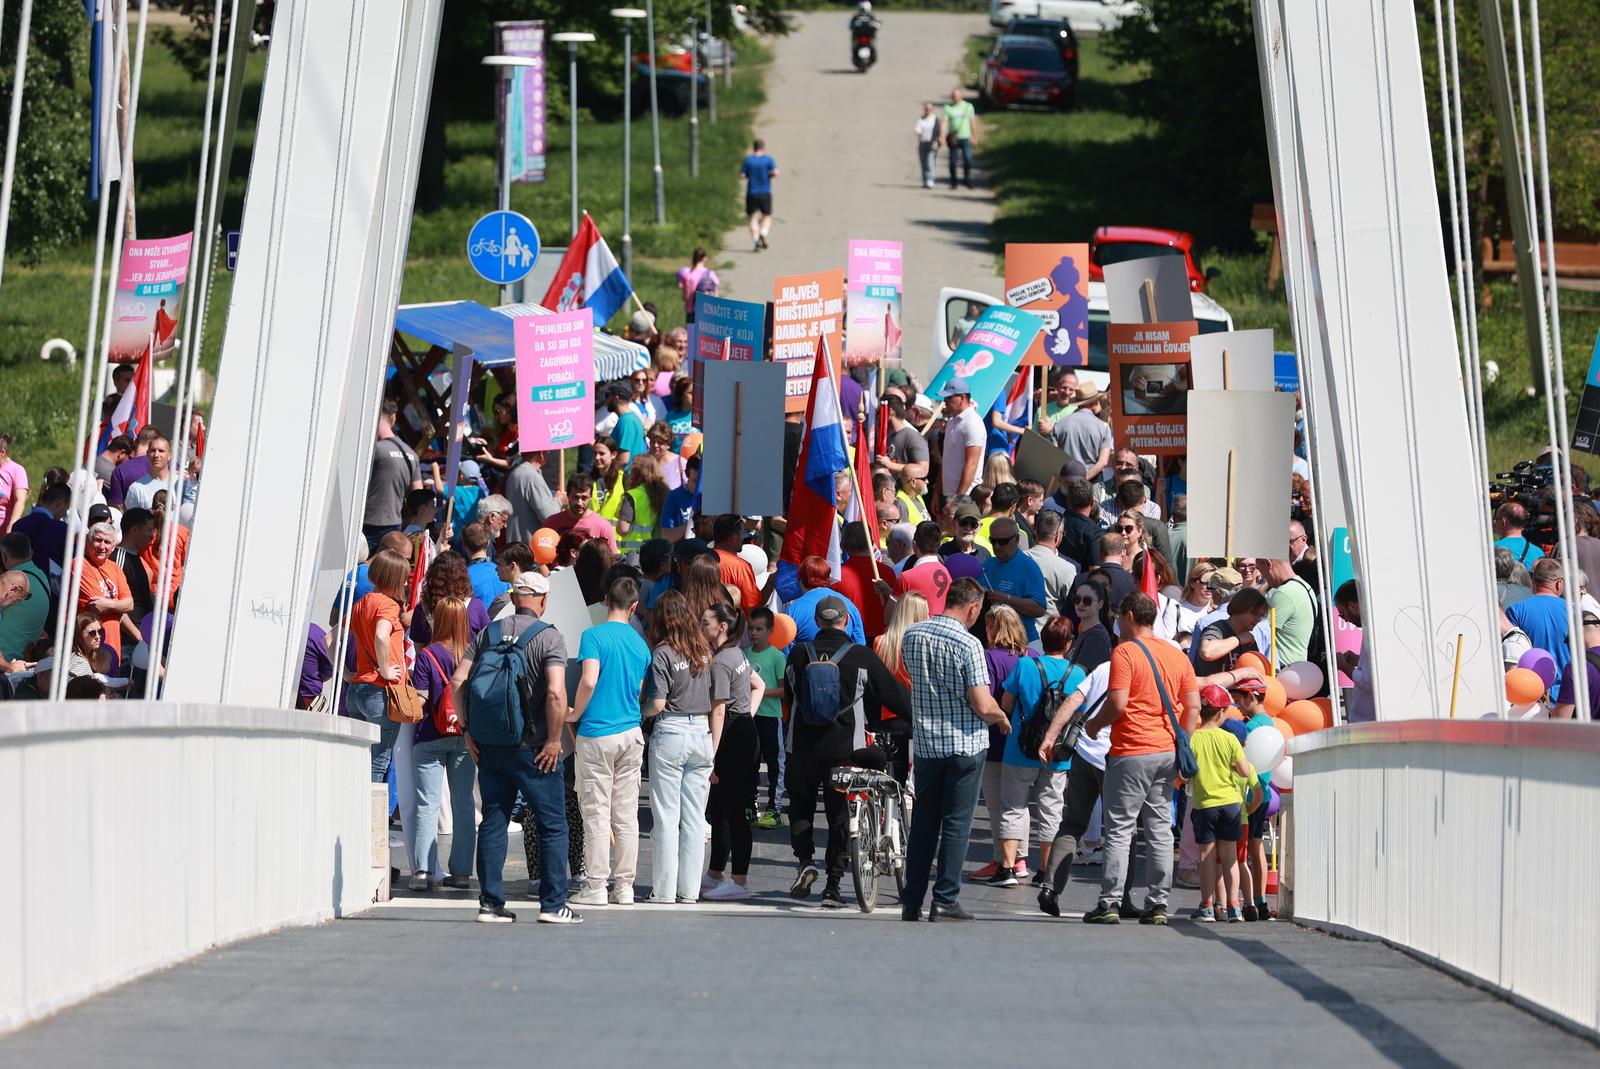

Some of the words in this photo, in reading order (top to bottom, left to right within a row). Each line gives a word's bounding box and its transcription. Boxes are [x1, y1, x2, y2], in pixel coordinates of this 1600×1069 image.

[128, 247, 143, 256] ONA
[143, 285, 151, 294] DA
[152, 284, 160, 294] SE
[734, 309, 748, 321] SVE
[573, 320, 584, 331] SAM
[776, 323, 806, 340] DANAS
[808, 320, 818, 337] JE
[737, 328, 754, 341] KOJI
[1133, 331, 1143, 341] JA
[1145, 331, 1170, 341] NISAM
[535, 342, 544, 351] DA
[547, 340, 557, 351] SU
[1112, 344, 1161, 354] POTENCIJALNI
[1125, 425, 1136, 434] JA
[1136, 424, 1154, 434] SAM
[1156, 422, 1185, 434] ČOVJEK
[1130, 437, 1186, 447] POTENCIJALOM
[933, 569, 948, 598] 9
